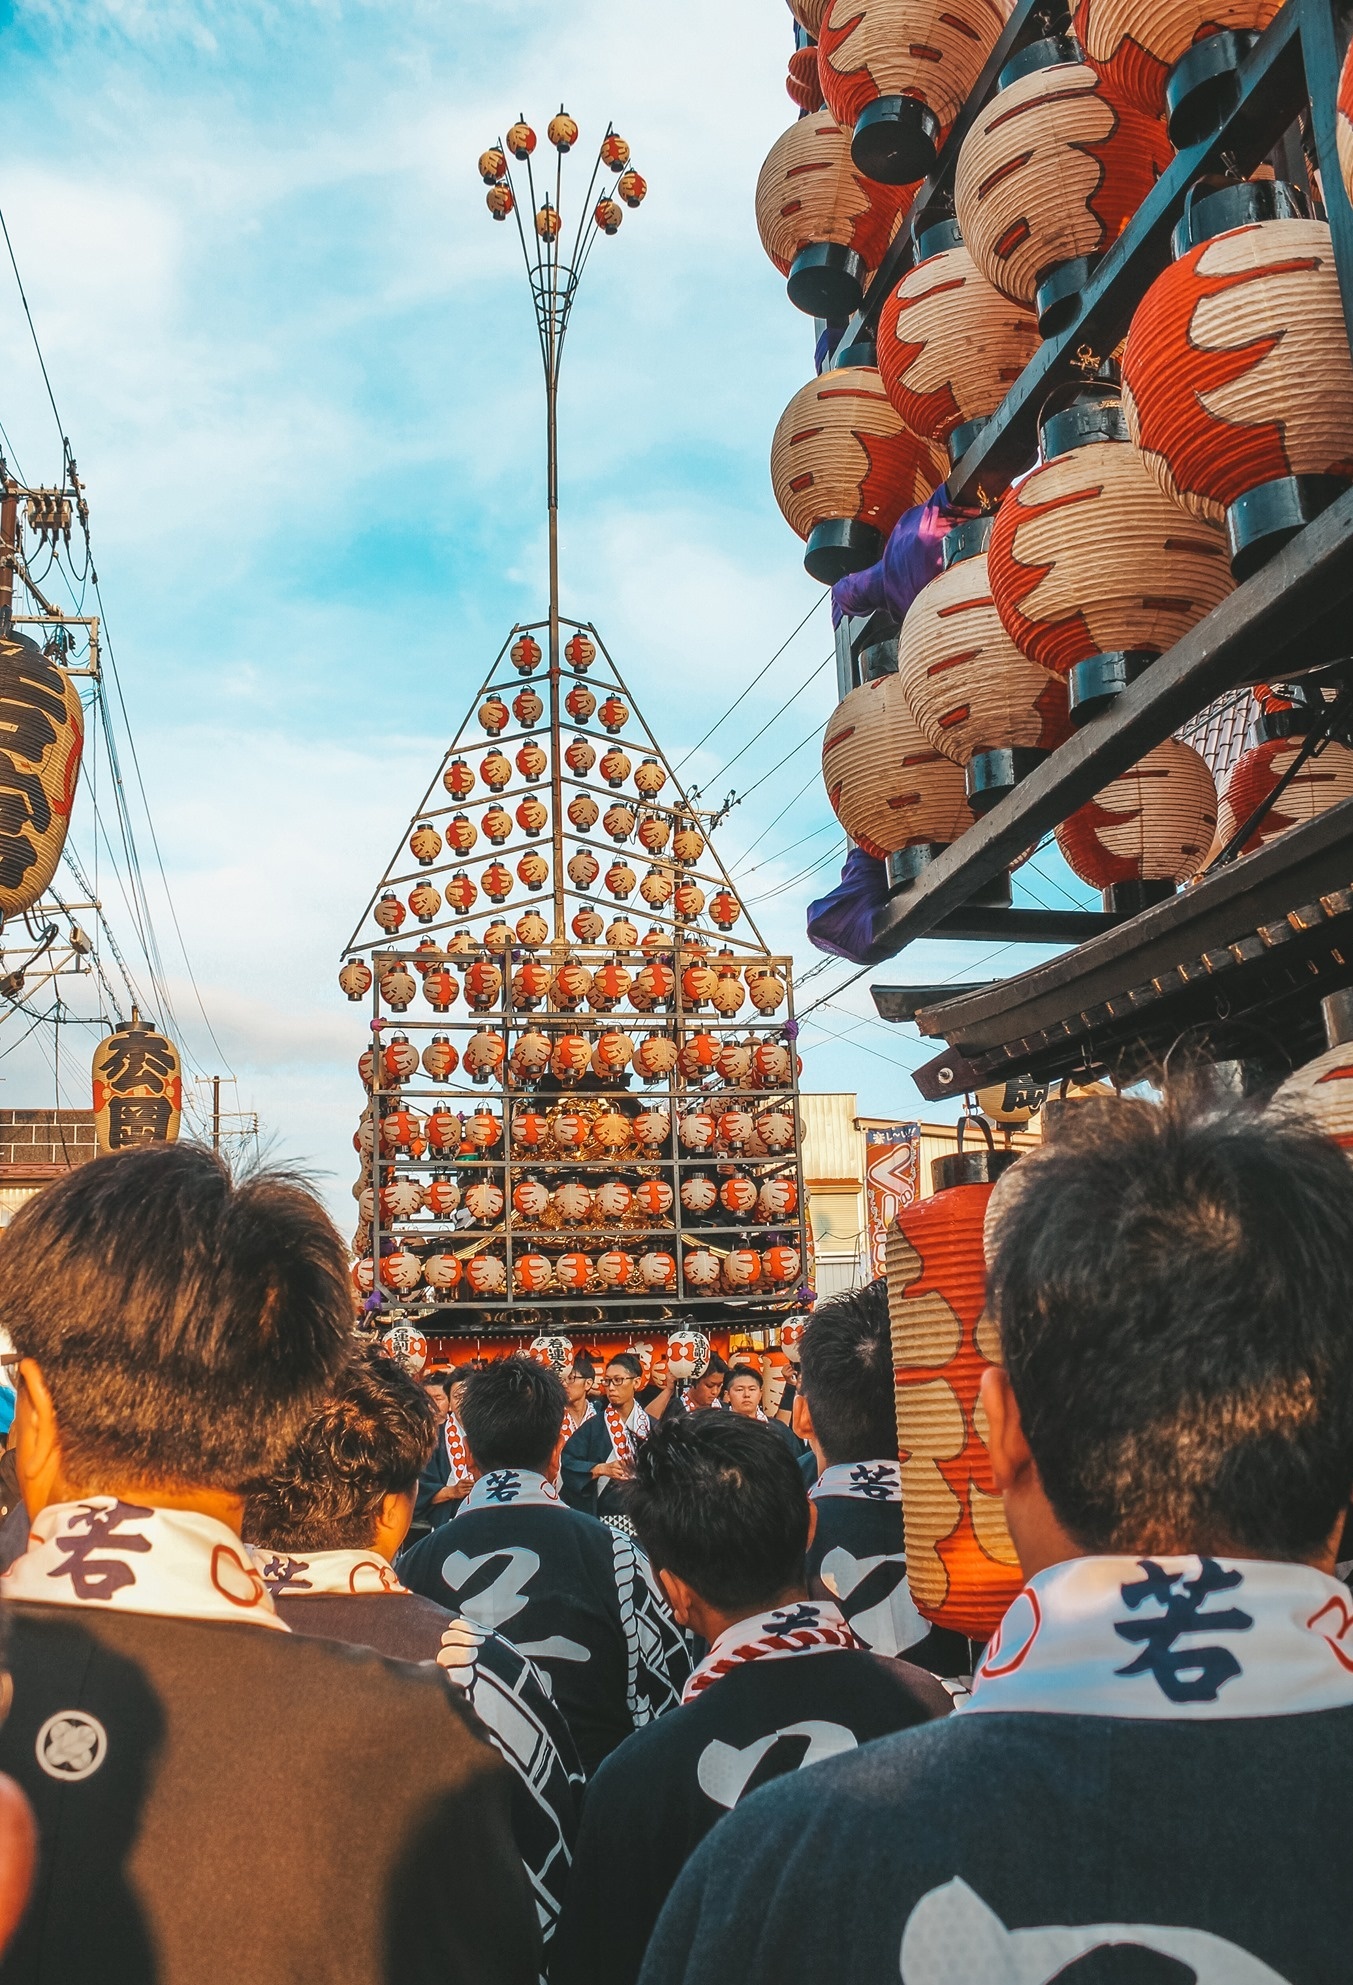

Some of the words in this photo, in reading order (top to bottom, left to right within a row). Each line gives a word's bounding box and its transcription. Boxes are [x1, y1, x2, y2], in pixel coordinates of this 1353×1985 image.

[486, 1470, 522, 1502] 若
[849, 1464, 900, 1501] 若
[47, 1499, 155, 1601] 若
[1113, 1556, 1255, 1705] 若
